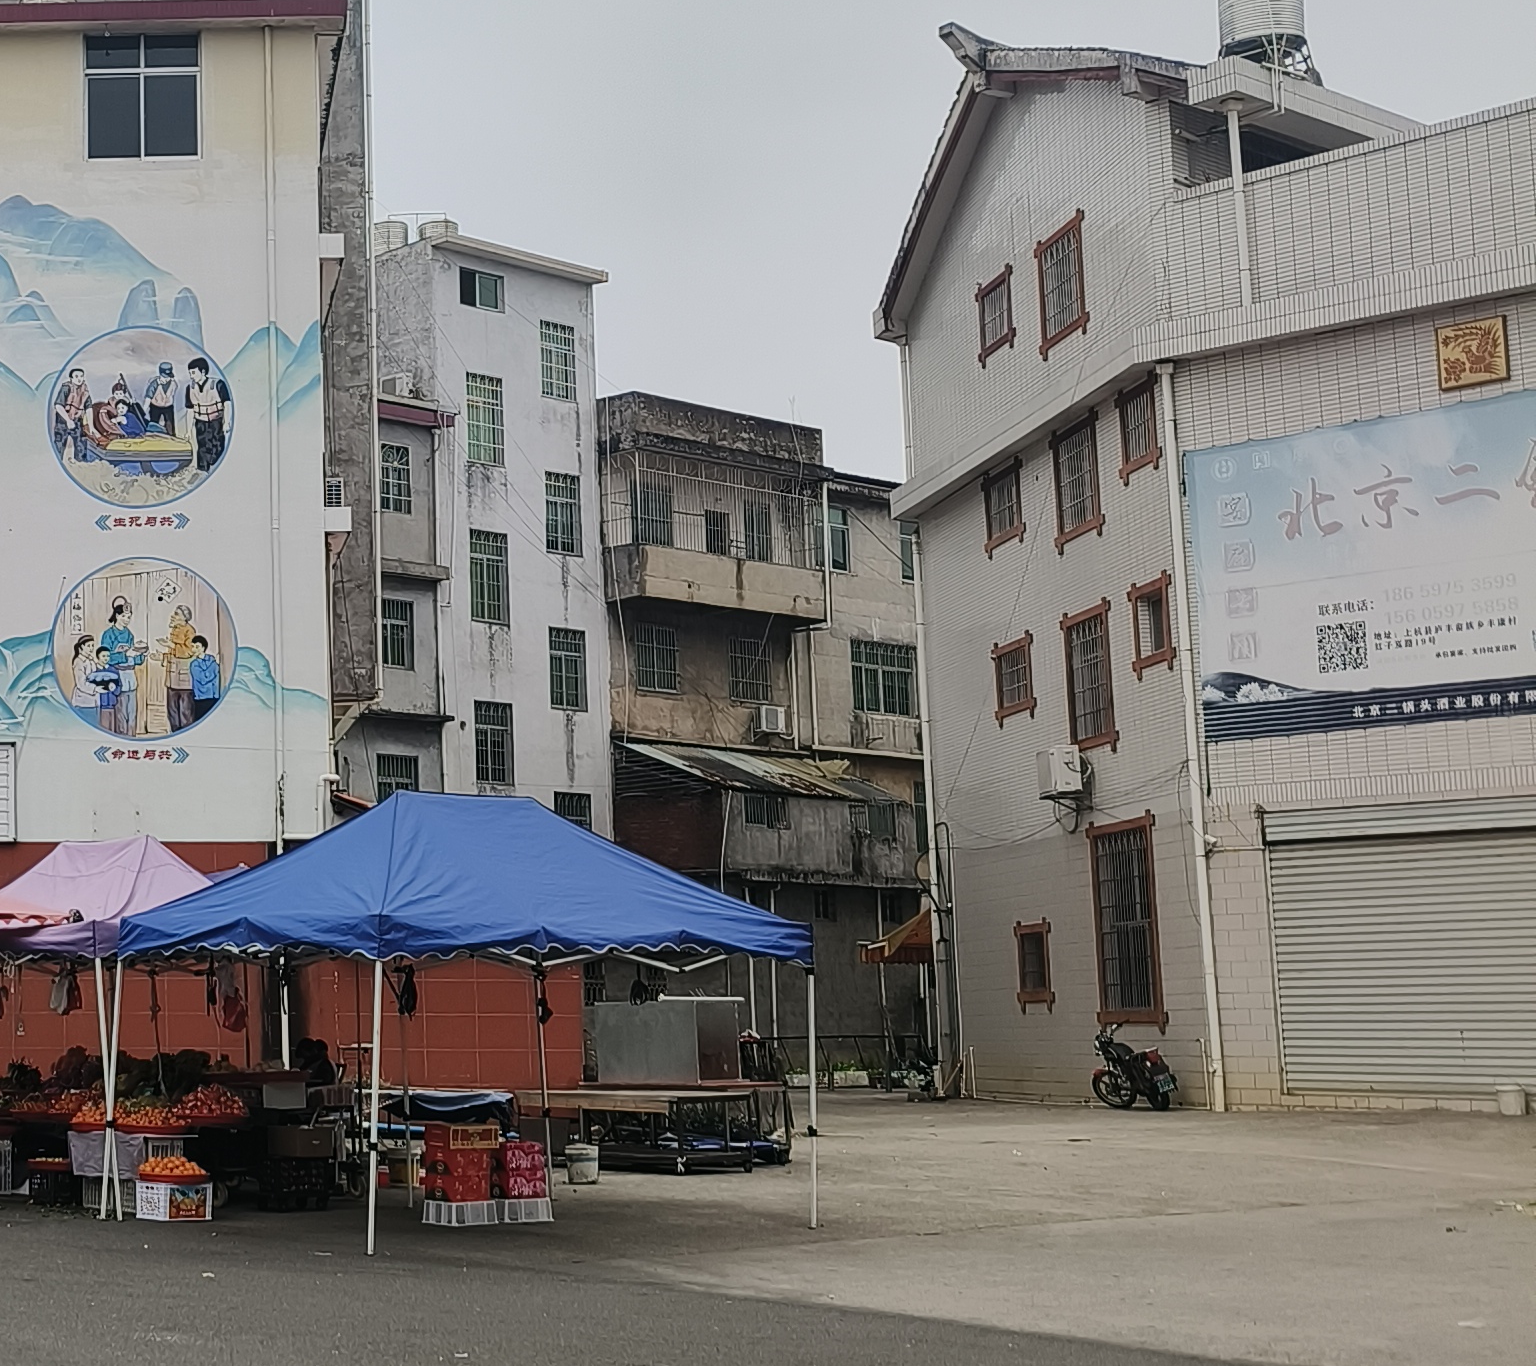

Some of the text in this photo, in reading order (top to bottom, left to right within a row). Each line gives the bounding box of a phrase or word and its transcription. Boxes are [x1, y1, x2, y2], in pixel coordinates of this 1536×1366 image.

[113, 516, 174, 527] 生死与共
[1383, 573, 1517, 603] 186 5975 3599
[1385, 597, 1519, 625] 156 0597 5858
[111, 749, 172, 760] 命运与共
